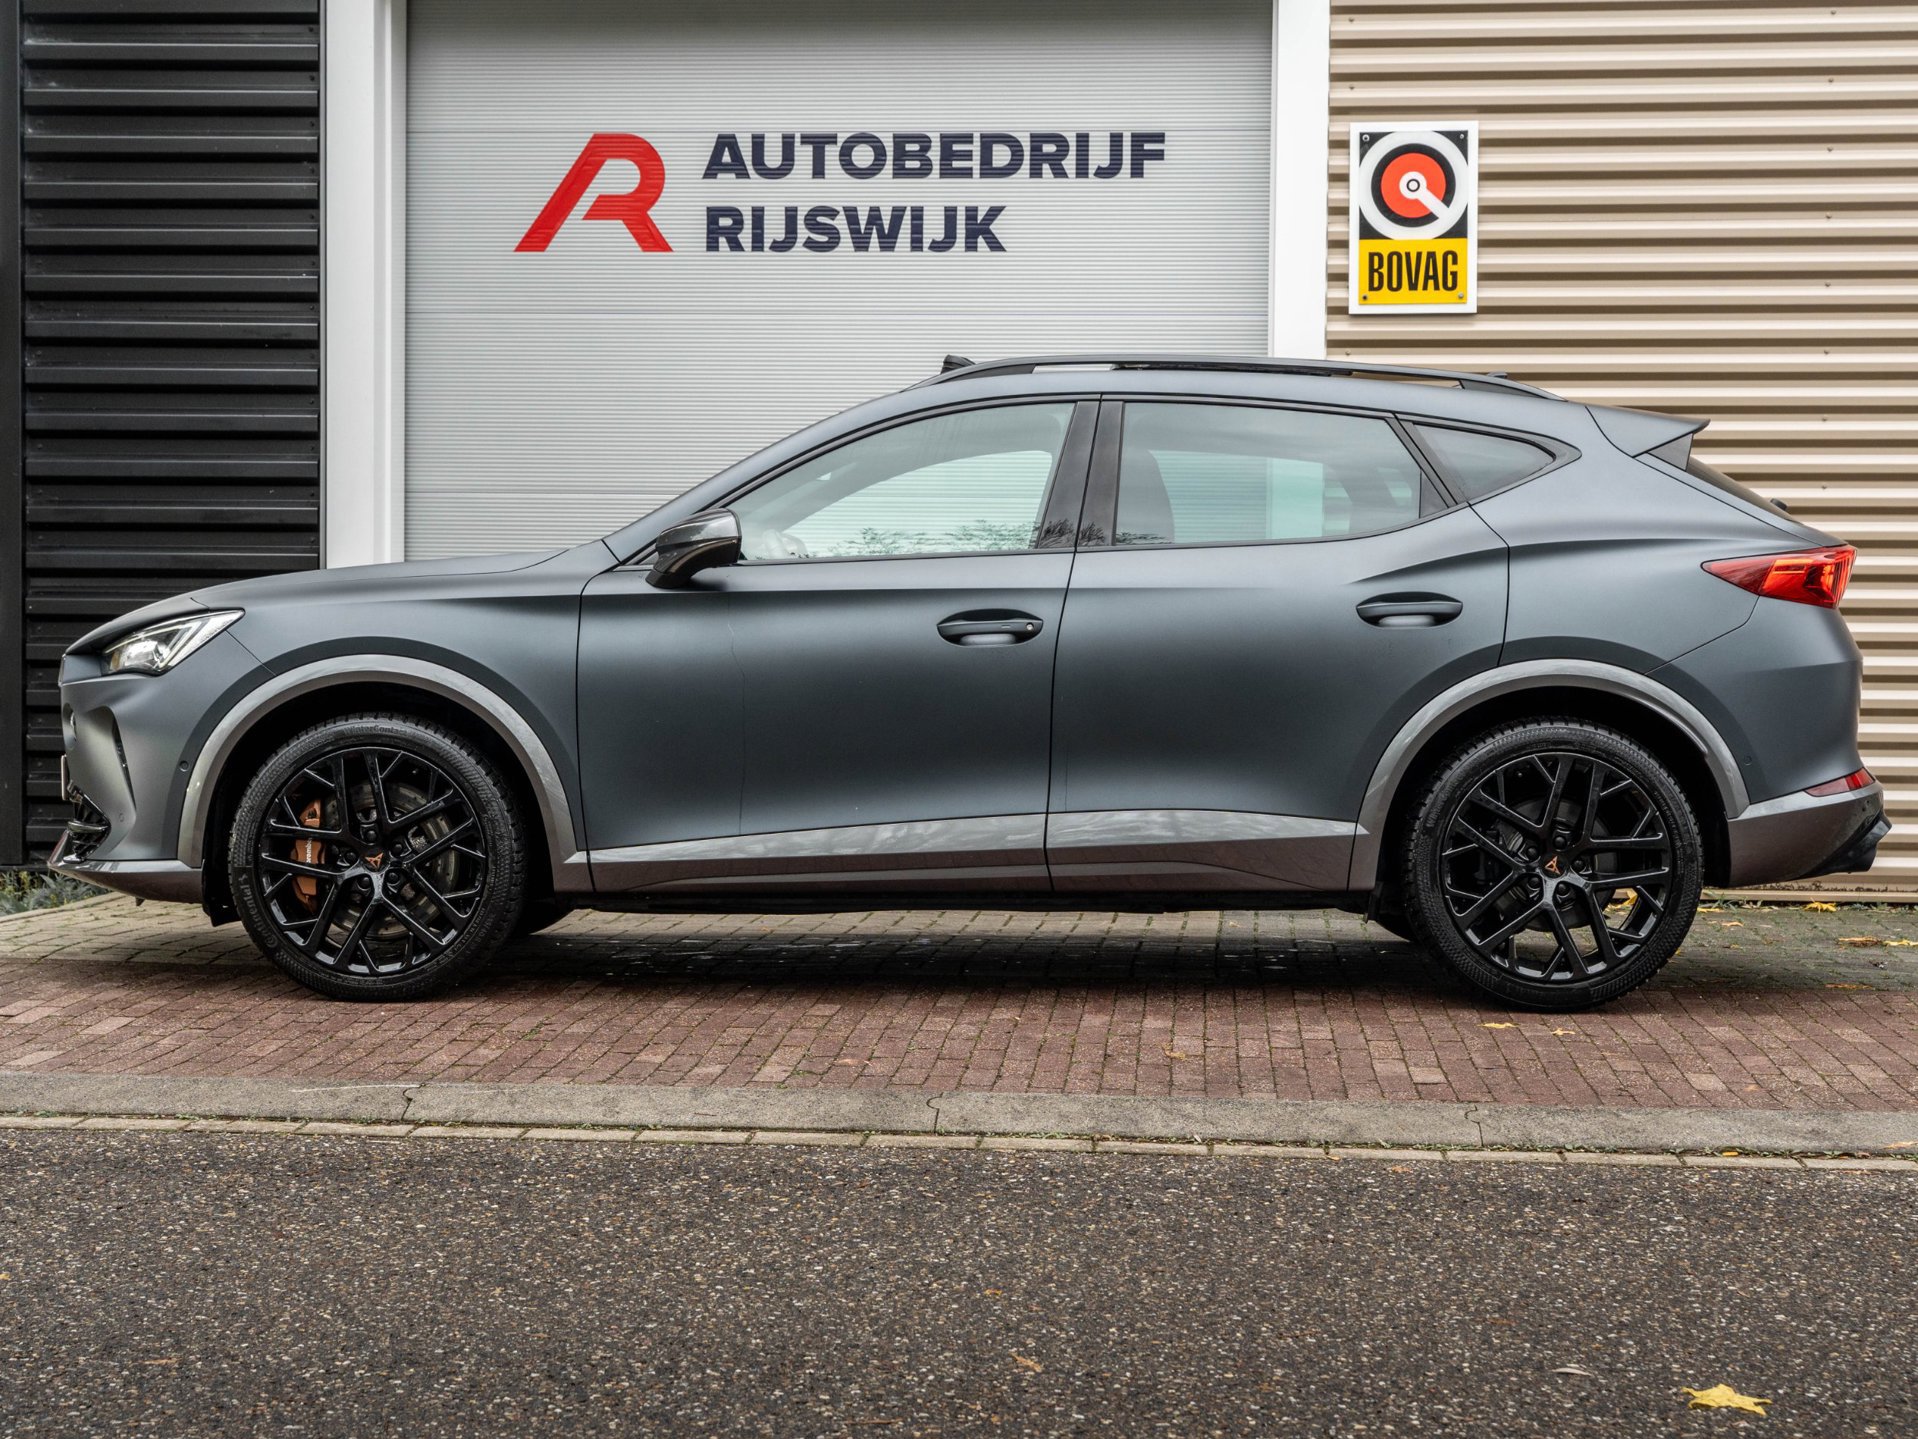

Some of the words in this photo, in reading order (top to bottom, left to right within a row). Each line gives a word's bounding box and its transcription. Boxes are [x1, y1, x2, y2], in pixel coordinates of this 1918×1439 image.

[702, 132, 1165, 179] AUTOBEDRIJF
[705, 206, 1007, 253] RIJSWIJK
[1368, 251, 1458, 292] BOVAG
